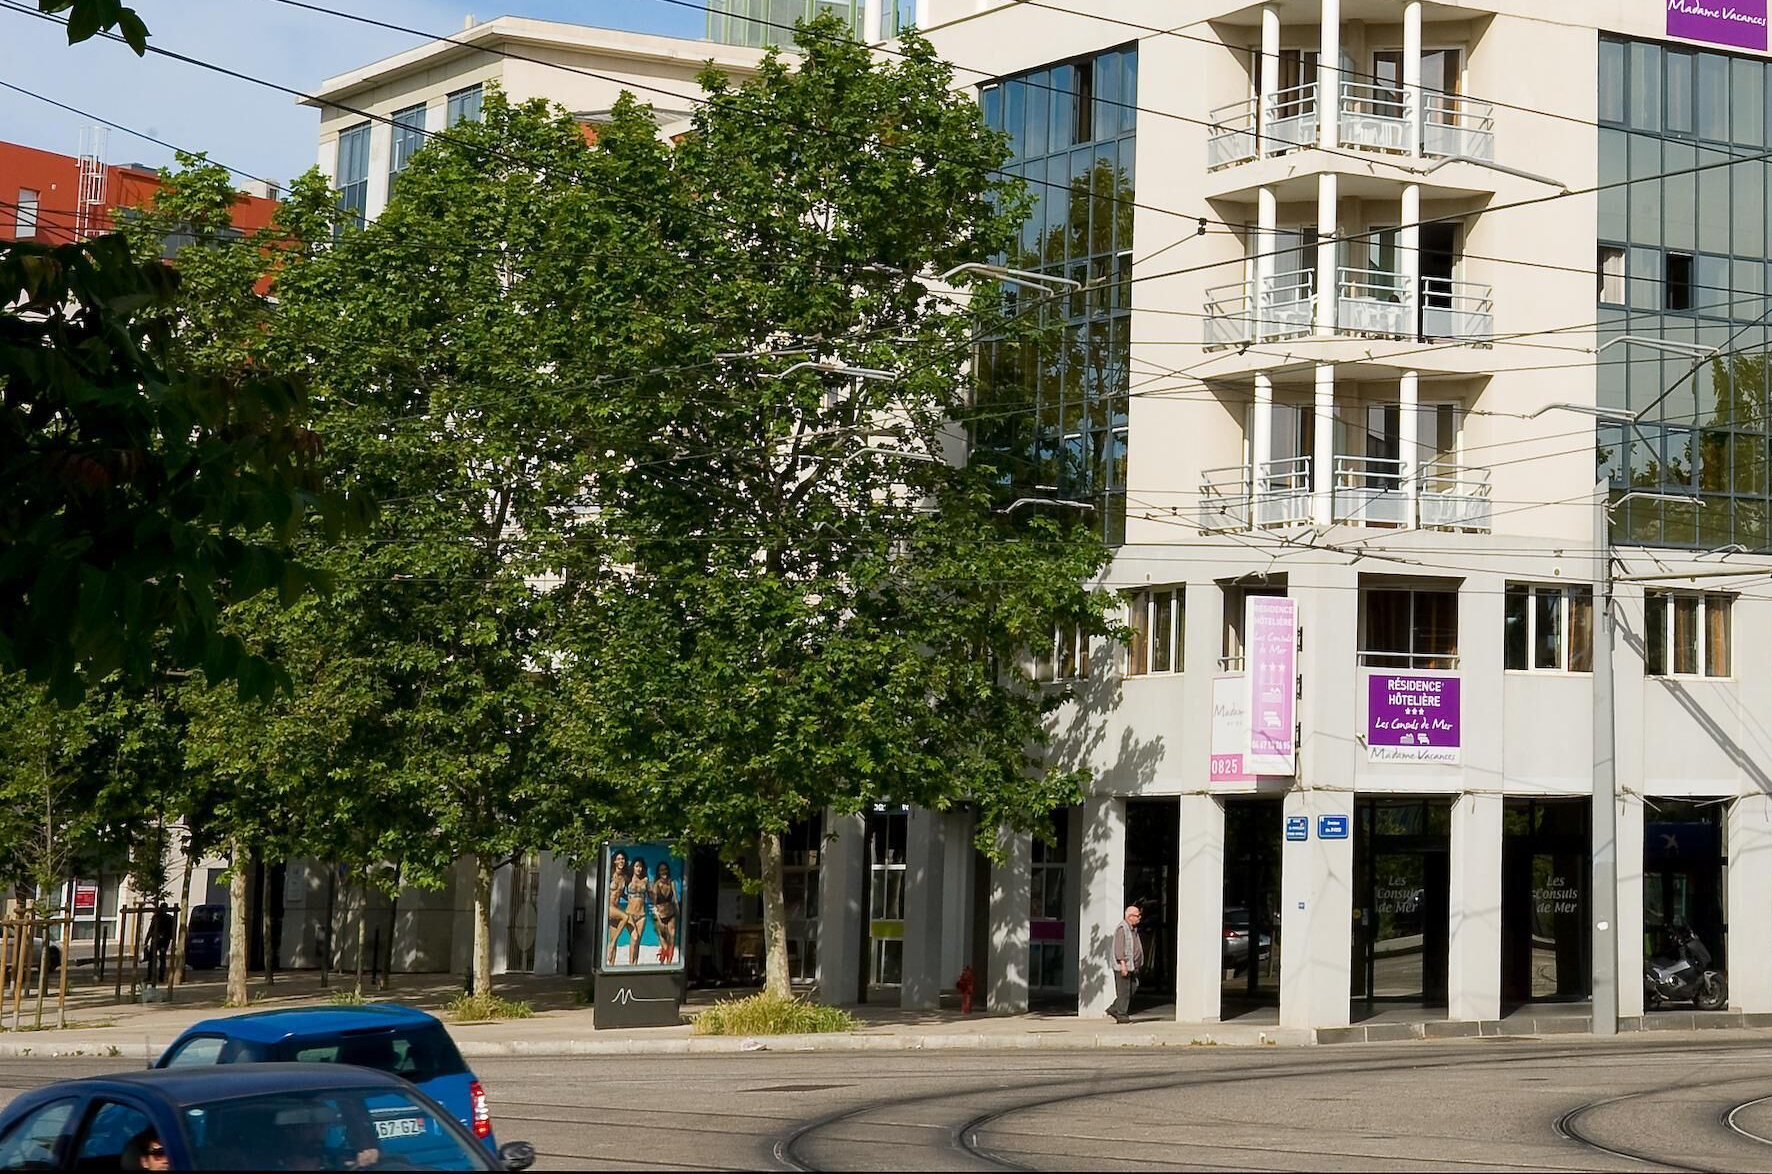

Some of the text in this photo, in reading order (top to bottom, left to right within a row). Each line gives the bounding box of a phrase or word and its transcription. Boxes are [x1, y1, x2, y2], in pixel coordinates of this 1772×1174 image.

[1722, 7, 1766, 26] Vacances
[1388, 677, 1441, 692] RÉSIDENCE
[1388, 693, 1440, 707] HÔTELIÈRE
[1375, 717, 1453, 731] Les Consuls de Mer
[1370, 747, 1456, 761] Madame Vacances
[1212, 759, 1238, 775] 0825
[1389, 876, 1406, 886] Les
[1547, 876, 1565, 886] Les
[1536, 888, 1578, 899] Consuls
[1379, 902, 1418, 913] de Mer
[1537, 902, 1577, 913] de Mer
